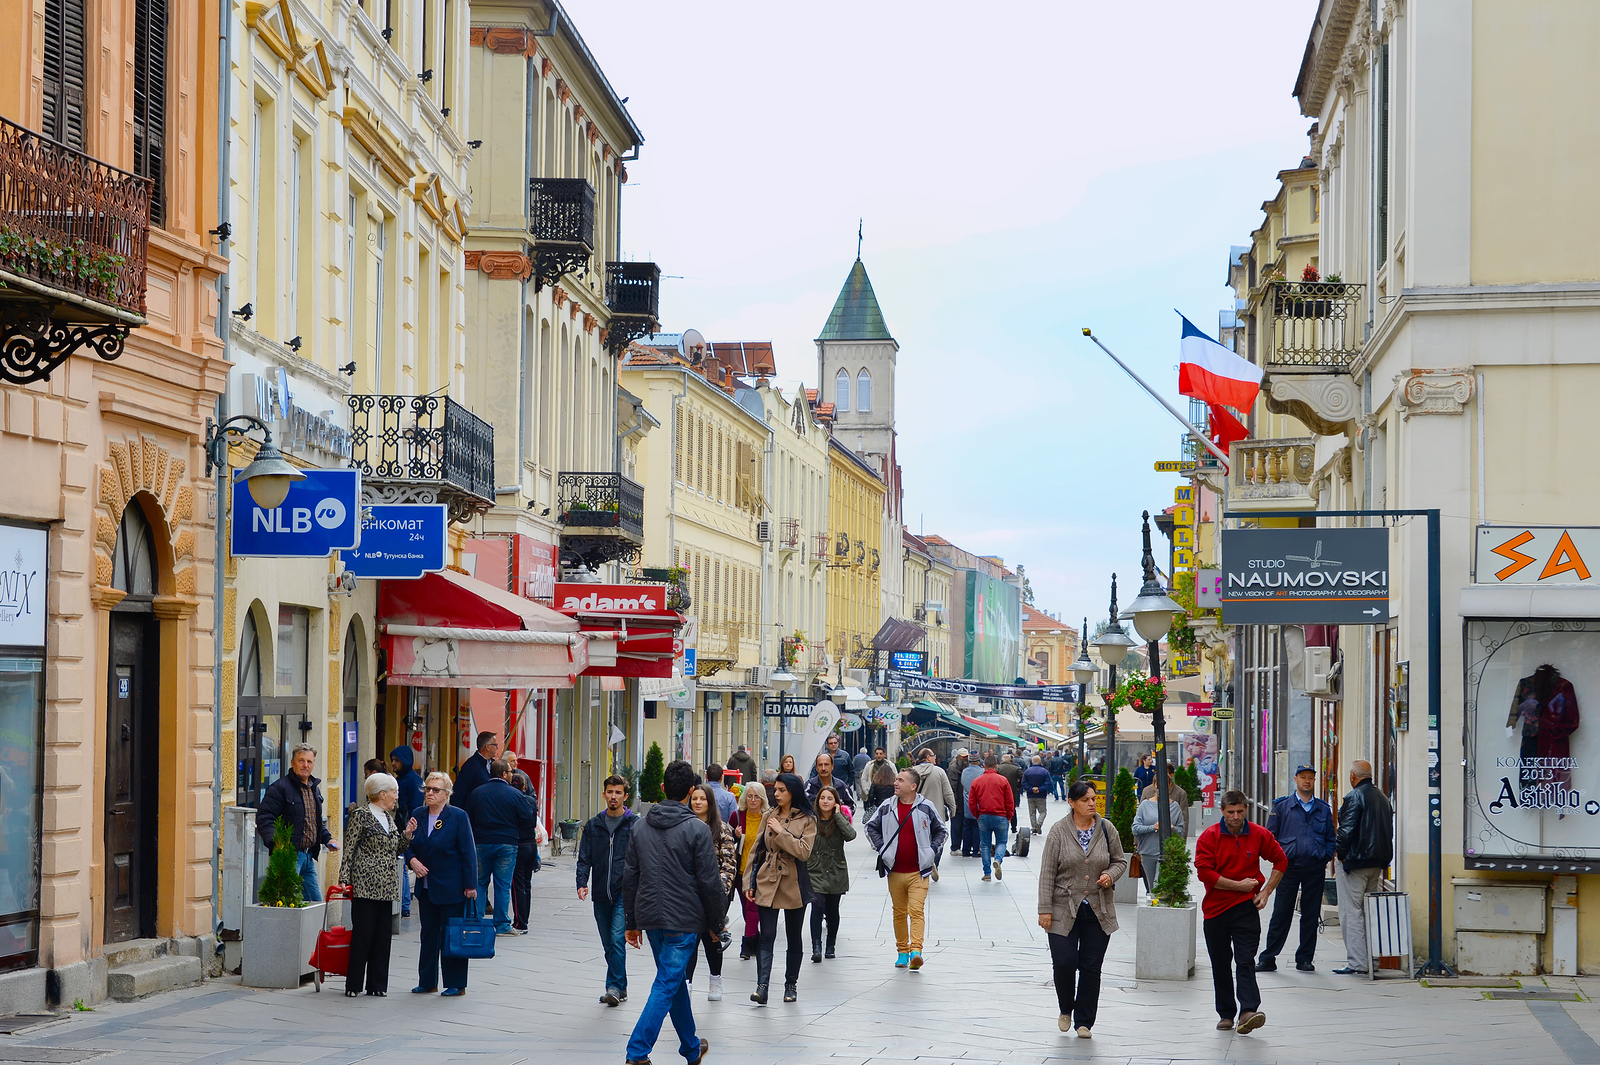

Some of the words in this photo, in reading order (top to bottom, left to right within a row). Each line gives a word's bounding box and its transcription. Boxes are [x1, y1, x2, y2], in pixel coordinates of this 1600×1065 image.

[253, 507, 312, 533] NLB
[361, 519, 424, 530] анкомат
[1248, 559, 1285, 569] STUDIO
[1228, 571, 1386, 588] NAUMOVSKI
[0, 570, 36, 617] NIX
[562, 593, 657, 610] adam's
[531, 645, 559, 653] ЗАЕДНО
[908, 678, 943, 690] JAMES
[945, 683, 977, 693] BOND
[1496, 757, 1580, 770] КОЛЕКЦИЈА
[1521, 768, 1554, 780] 2013
[1489, 776, 1581, 815] Astibo
